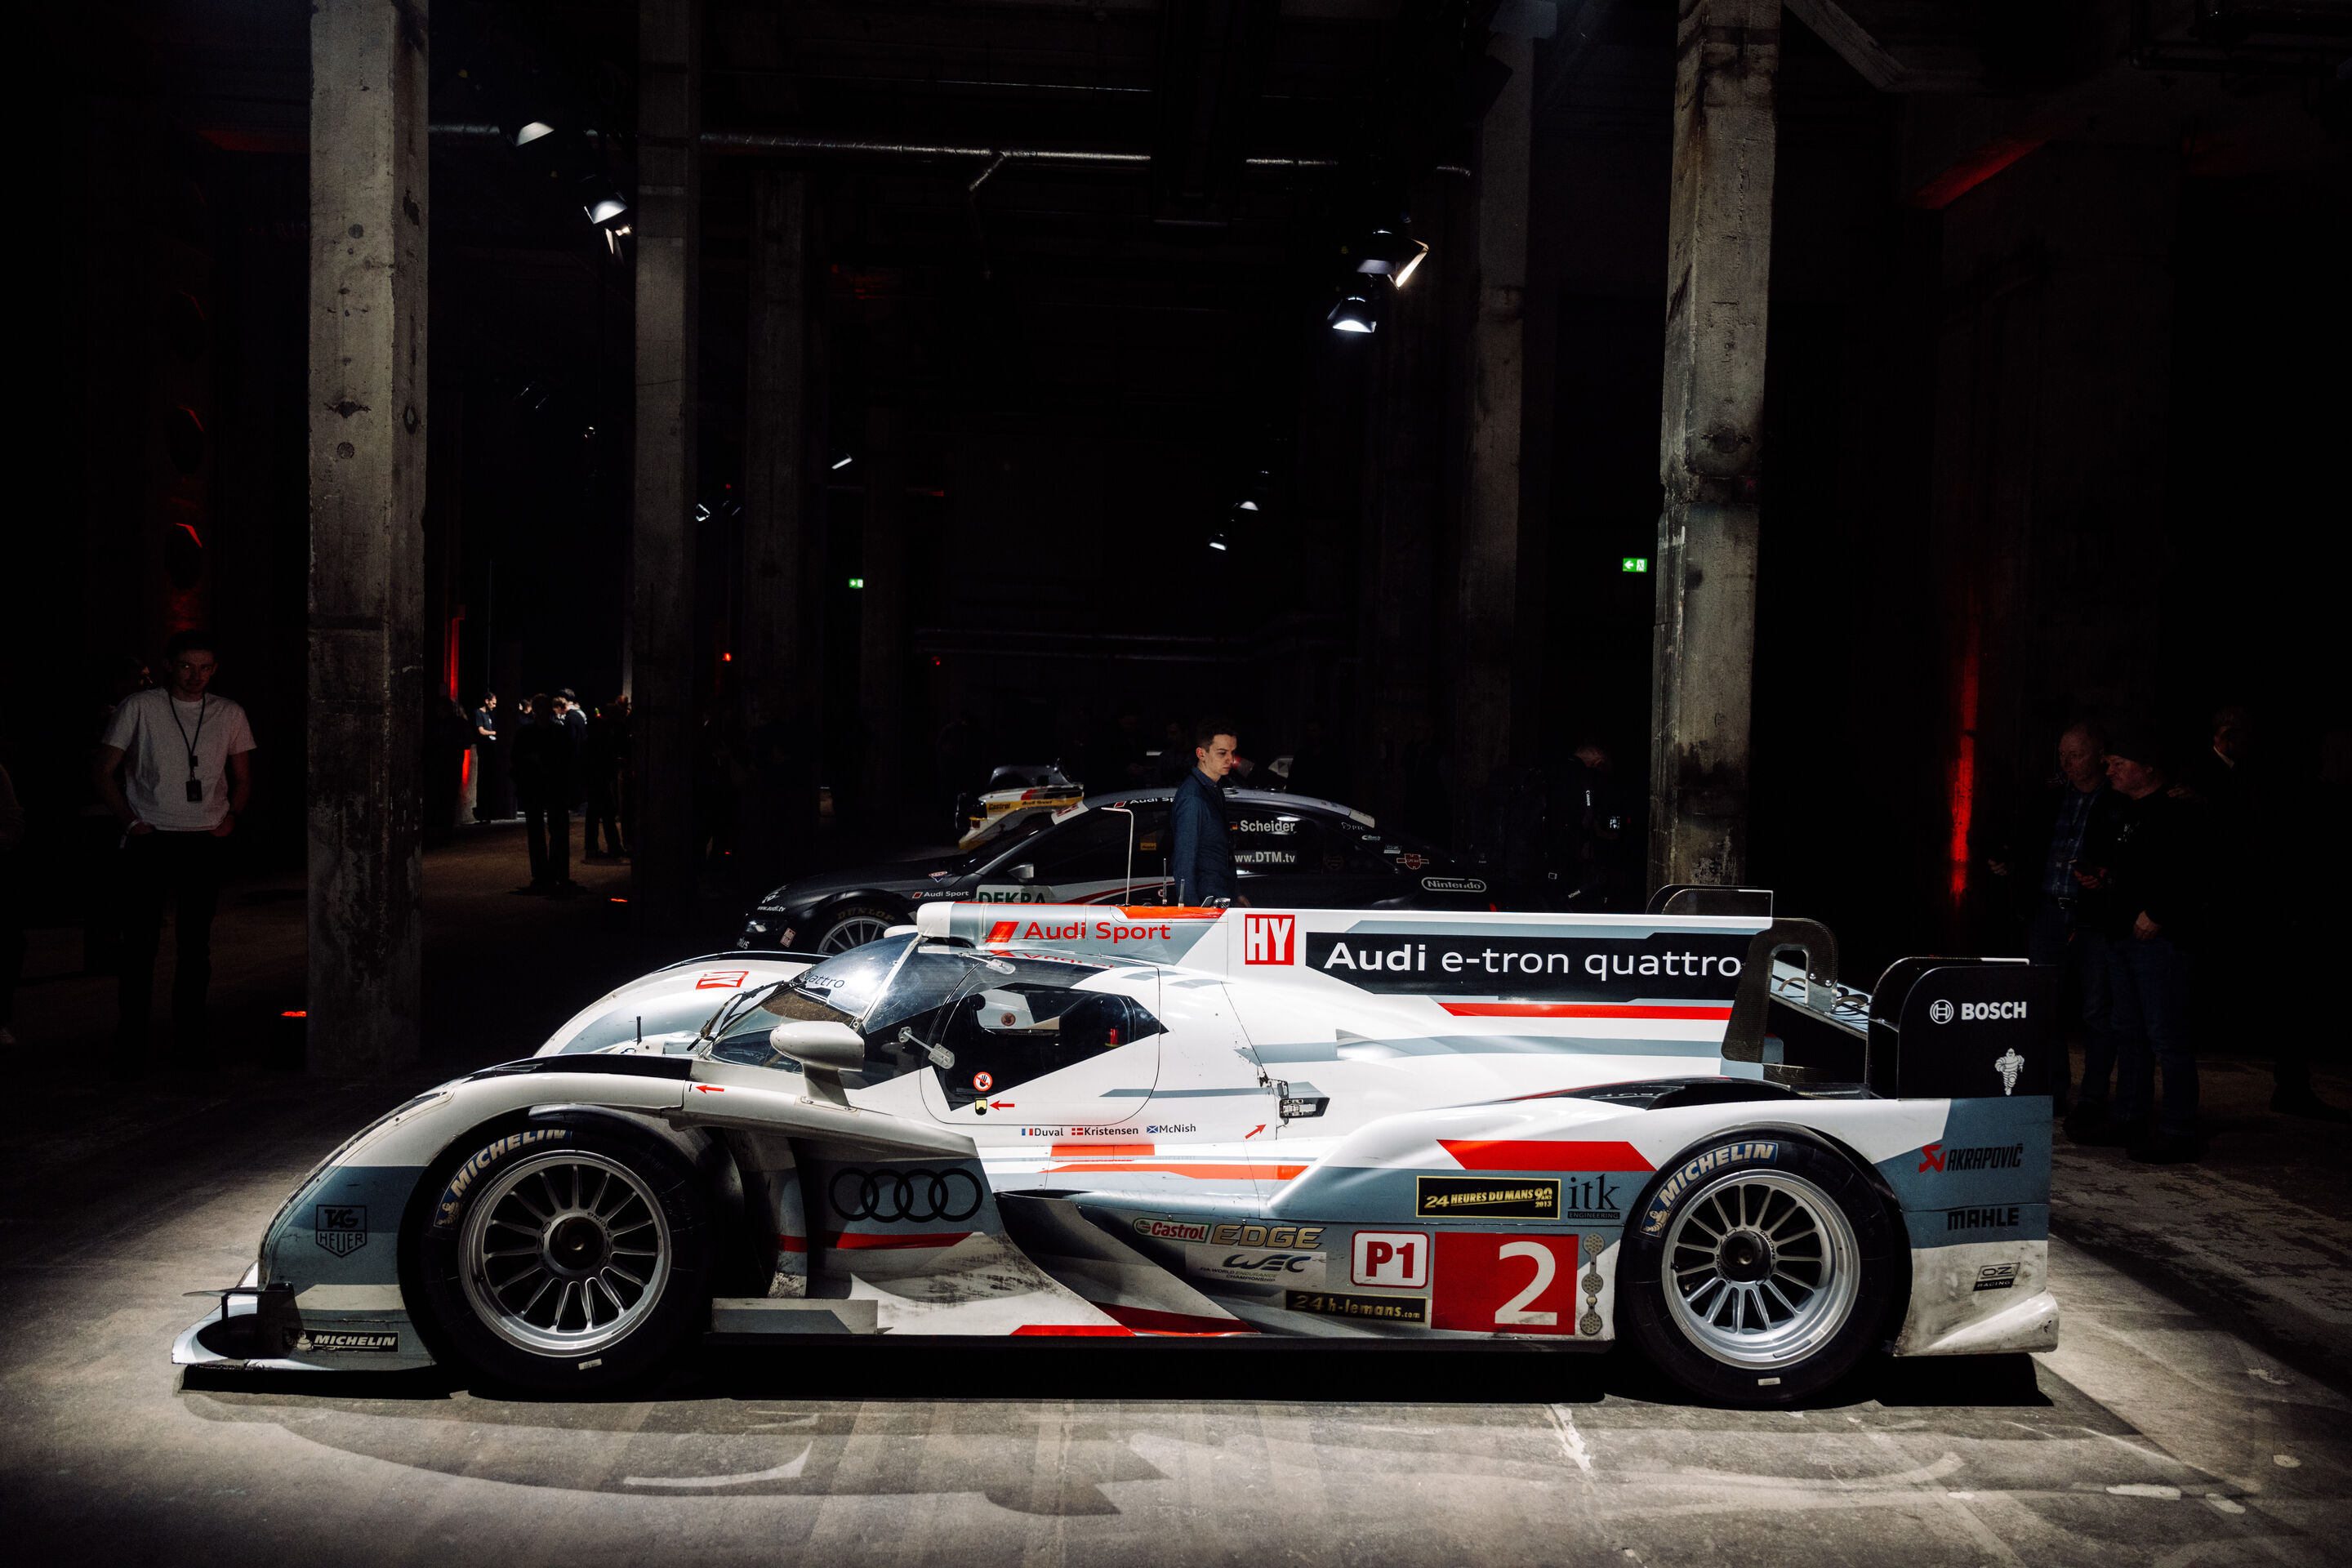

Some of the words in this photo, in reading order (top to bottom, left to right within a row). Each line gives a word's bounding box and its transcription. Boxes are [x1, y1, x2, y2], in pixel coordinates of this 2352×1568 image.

[1240, 819, 1295, 832] Scheider
[1234, 851, 1295, 862] ww.DTM.tv
[1427, 880, 1482, 890] Nintendo
[978, 891, 1045, 903] DEKRA
[836, 907, 896, 921] DUNLOP
[1023, 921, 1086, 939] Audi
[1095, 921, 1171, 944] Sport
[1246, 917, 1293, 961] HY
[1323, 942, 1426, 972] Audi
[1441, 948, 1570, 973] e-tron
[1584, 951, 1741, 982] quattro
[1961, 1001, 2027, 1020] BOSCH
[1035, 1127, 1064, 1137] Duval
[1084, 1126, 1139, 1136] Kristensen
[1159, 1123, 1196, 1134] McNish
[450, 1129, 568, 1198] MICHELIN
[1659, 1143, 1775, 1208] MICHELIN
[1424, 1195, 1450, 1209] 24
[1450, 1193, 1486, 1205] HEURES
[1489, 1191, 1503, 1201] DU
[1504, 1189, 1534, 1200] MANS
[1568, 1174, 1621, 1210] itk
[1535, 1200, 1552, 1209] 2013
[324, 1209, 359, 1228] TAG
[1948, 1208, 2019, 1230] MAHLE
[319, 1233, 363, 1254] HEUER
[1152, 1222, 1205, 1241] Castrol
[1210, 1224, 1326, 1250] EDGE
[1222, 1254, 1312, 1273] WEC
[1366, 1241, 1414, 1279] P1
[1226, 1274, 1276, 1282] CHAMPIONSHIP
[1494, 1241, 1557, 1326] 2
[1977, 1280, 2011, 1288] RACING
[314, 1334, 396, 1347] MICHELIN
